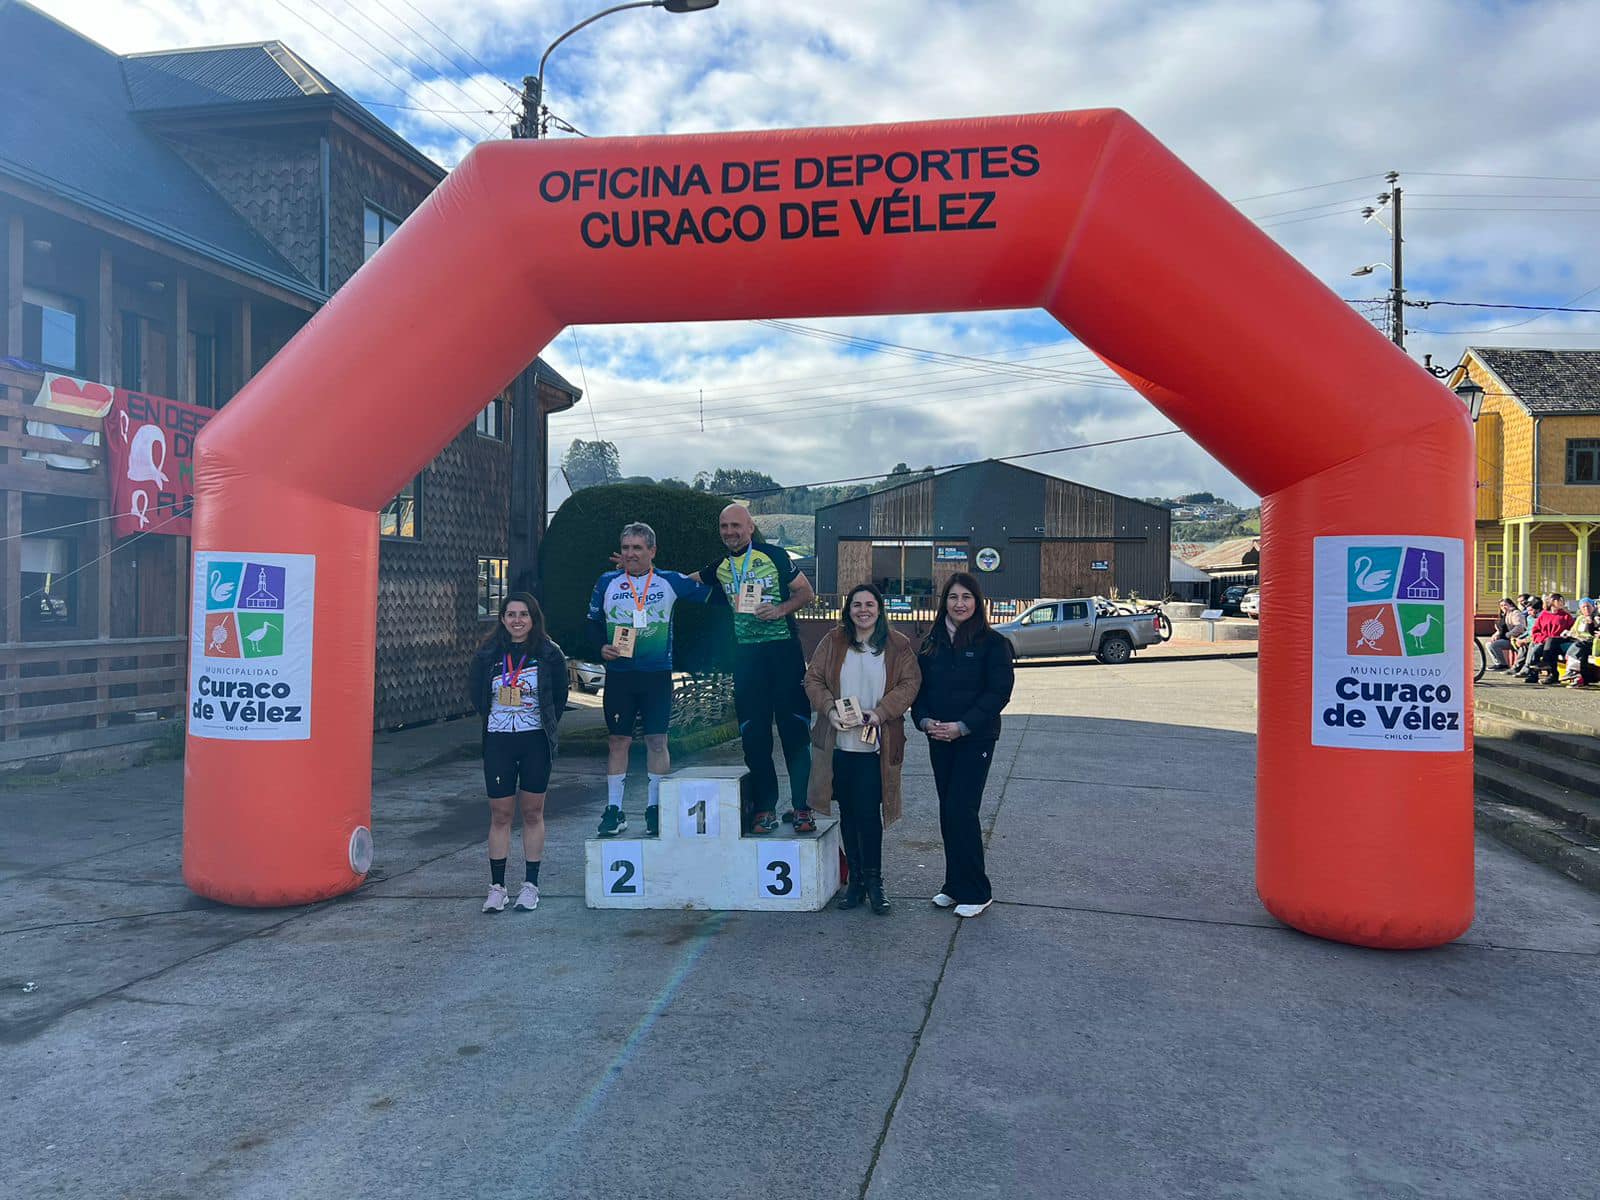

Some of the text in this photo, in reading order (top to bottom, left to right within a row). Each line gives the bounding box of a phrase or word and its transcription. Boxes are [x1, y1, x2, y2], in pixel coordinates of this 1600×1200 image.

[539, 145, 1040, 203] OFICINA DE DEPORTES
[580, 187, 997, 248] CURACO DE VÉLEZ
[127, 393, 161, 423] EN
[206, 666, 279, 676] MUNICIPALIDAD
[1350, 666, 1442, 677] MUNICIPALIDAD
[198, 675, 291, 699] Curaco
[1335, 676, 1452, 703] Curaco
[192, 698, 302, 723] de Vélez
[1323, 703, 1459, 731] de Vélez
[687, 800, 706, 835] 1
[609, 859, 637, 894] 2
[765, 860, 793, 895] 3
